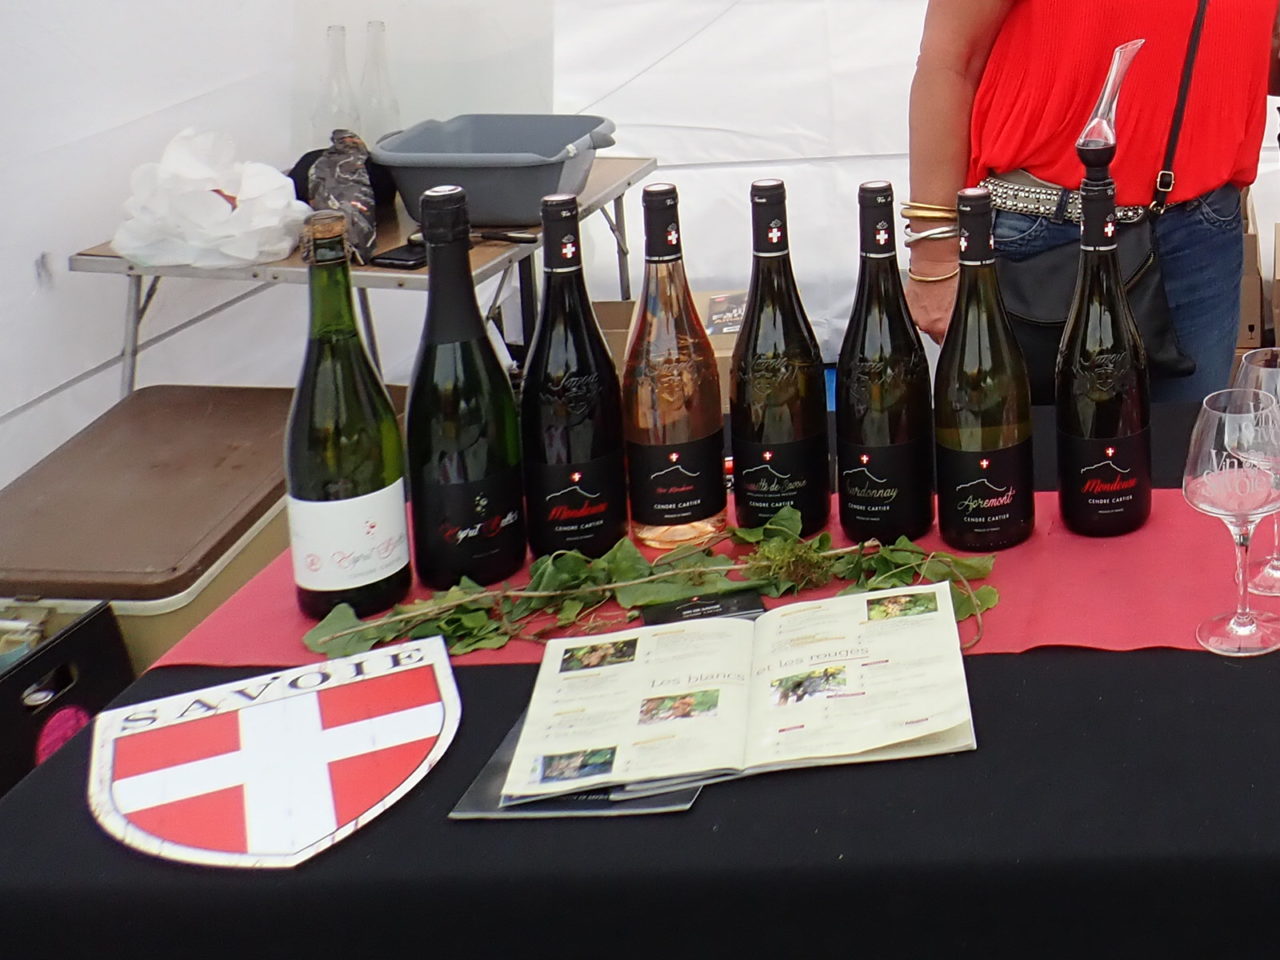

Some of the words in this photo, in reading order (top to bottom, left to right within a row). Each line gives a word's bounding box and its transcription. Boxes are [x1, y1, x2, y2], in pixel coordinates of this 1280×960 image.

[1210, 448, 1239, 473] Vin
[956, 485, 1016, 515] Apremont
[1112, 494, 1133, 504] CARTIER
[987, 513, 1010, 522] CARTIER
[118, 644, 426, 733] SAVOIE
